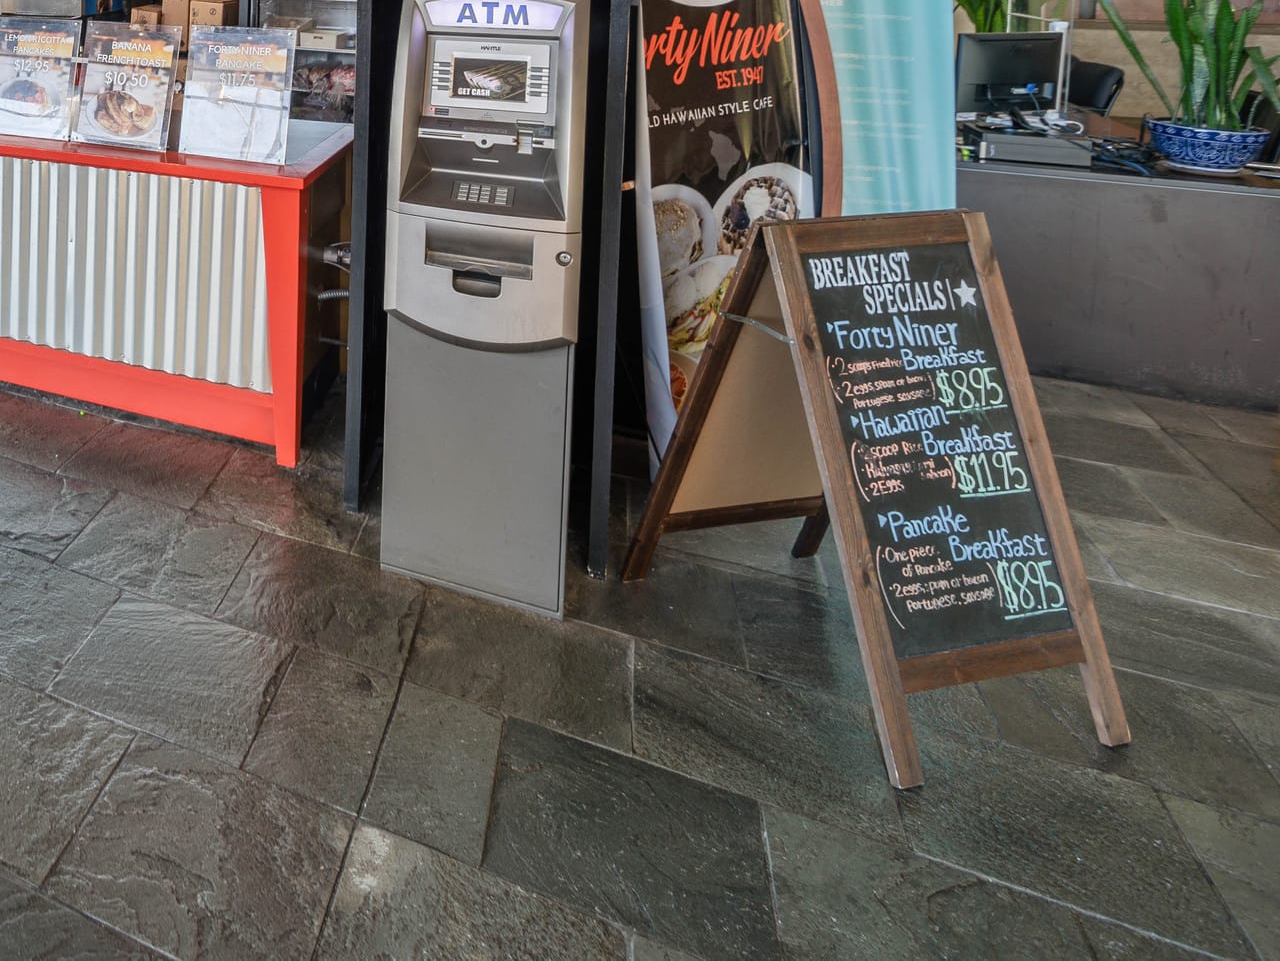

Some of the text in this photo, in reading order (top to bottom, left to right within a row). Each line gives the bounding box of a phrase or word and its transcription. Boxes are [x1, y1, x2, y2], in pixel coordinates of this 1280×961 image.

[456, 1, 530, 26] ATM
[5, 33, 66, 46] LEMON RICOTTA
[12, 45, 55, 57] PANCAKES
[111, 41, 153, 53] BANANA
[241, 46, 273, 56] NINER
[643, 10, 792, 85] rty Niner
[13, 59, 50, 73] $12.95
[96, 54, 167, 69] FRENCH TOAST
[215, 58, 263, 69] PANCAKE
[104, 71, 149, 88] $10.50
[220, 72, 257, 87] $11.75
[457, 87, 491, 97] GET CASH
[648, 96, 774, 128] LD HAWAIIAN STYLE CAFE
[809, 251, 911, 290] BREAKFAST
[862, 279, 947, 315] SPECIALS
[833, 314, 958, 350] Forty Niner
[900, 345, 987, 372] Breakfast
[935, 367, 1004, 410] $8.95
[859, 405, 950, 440] Hawaiian
[920, 424, 1017, 456] Breakfast
[955, 451, 1028, 493] $11.95
[887, 504, 970, 542] Pancake
[948, 528, 1047, 562] Breakfast
[902, 564, 914, 577] of
[997, 559, 1065, 613] $8.95
